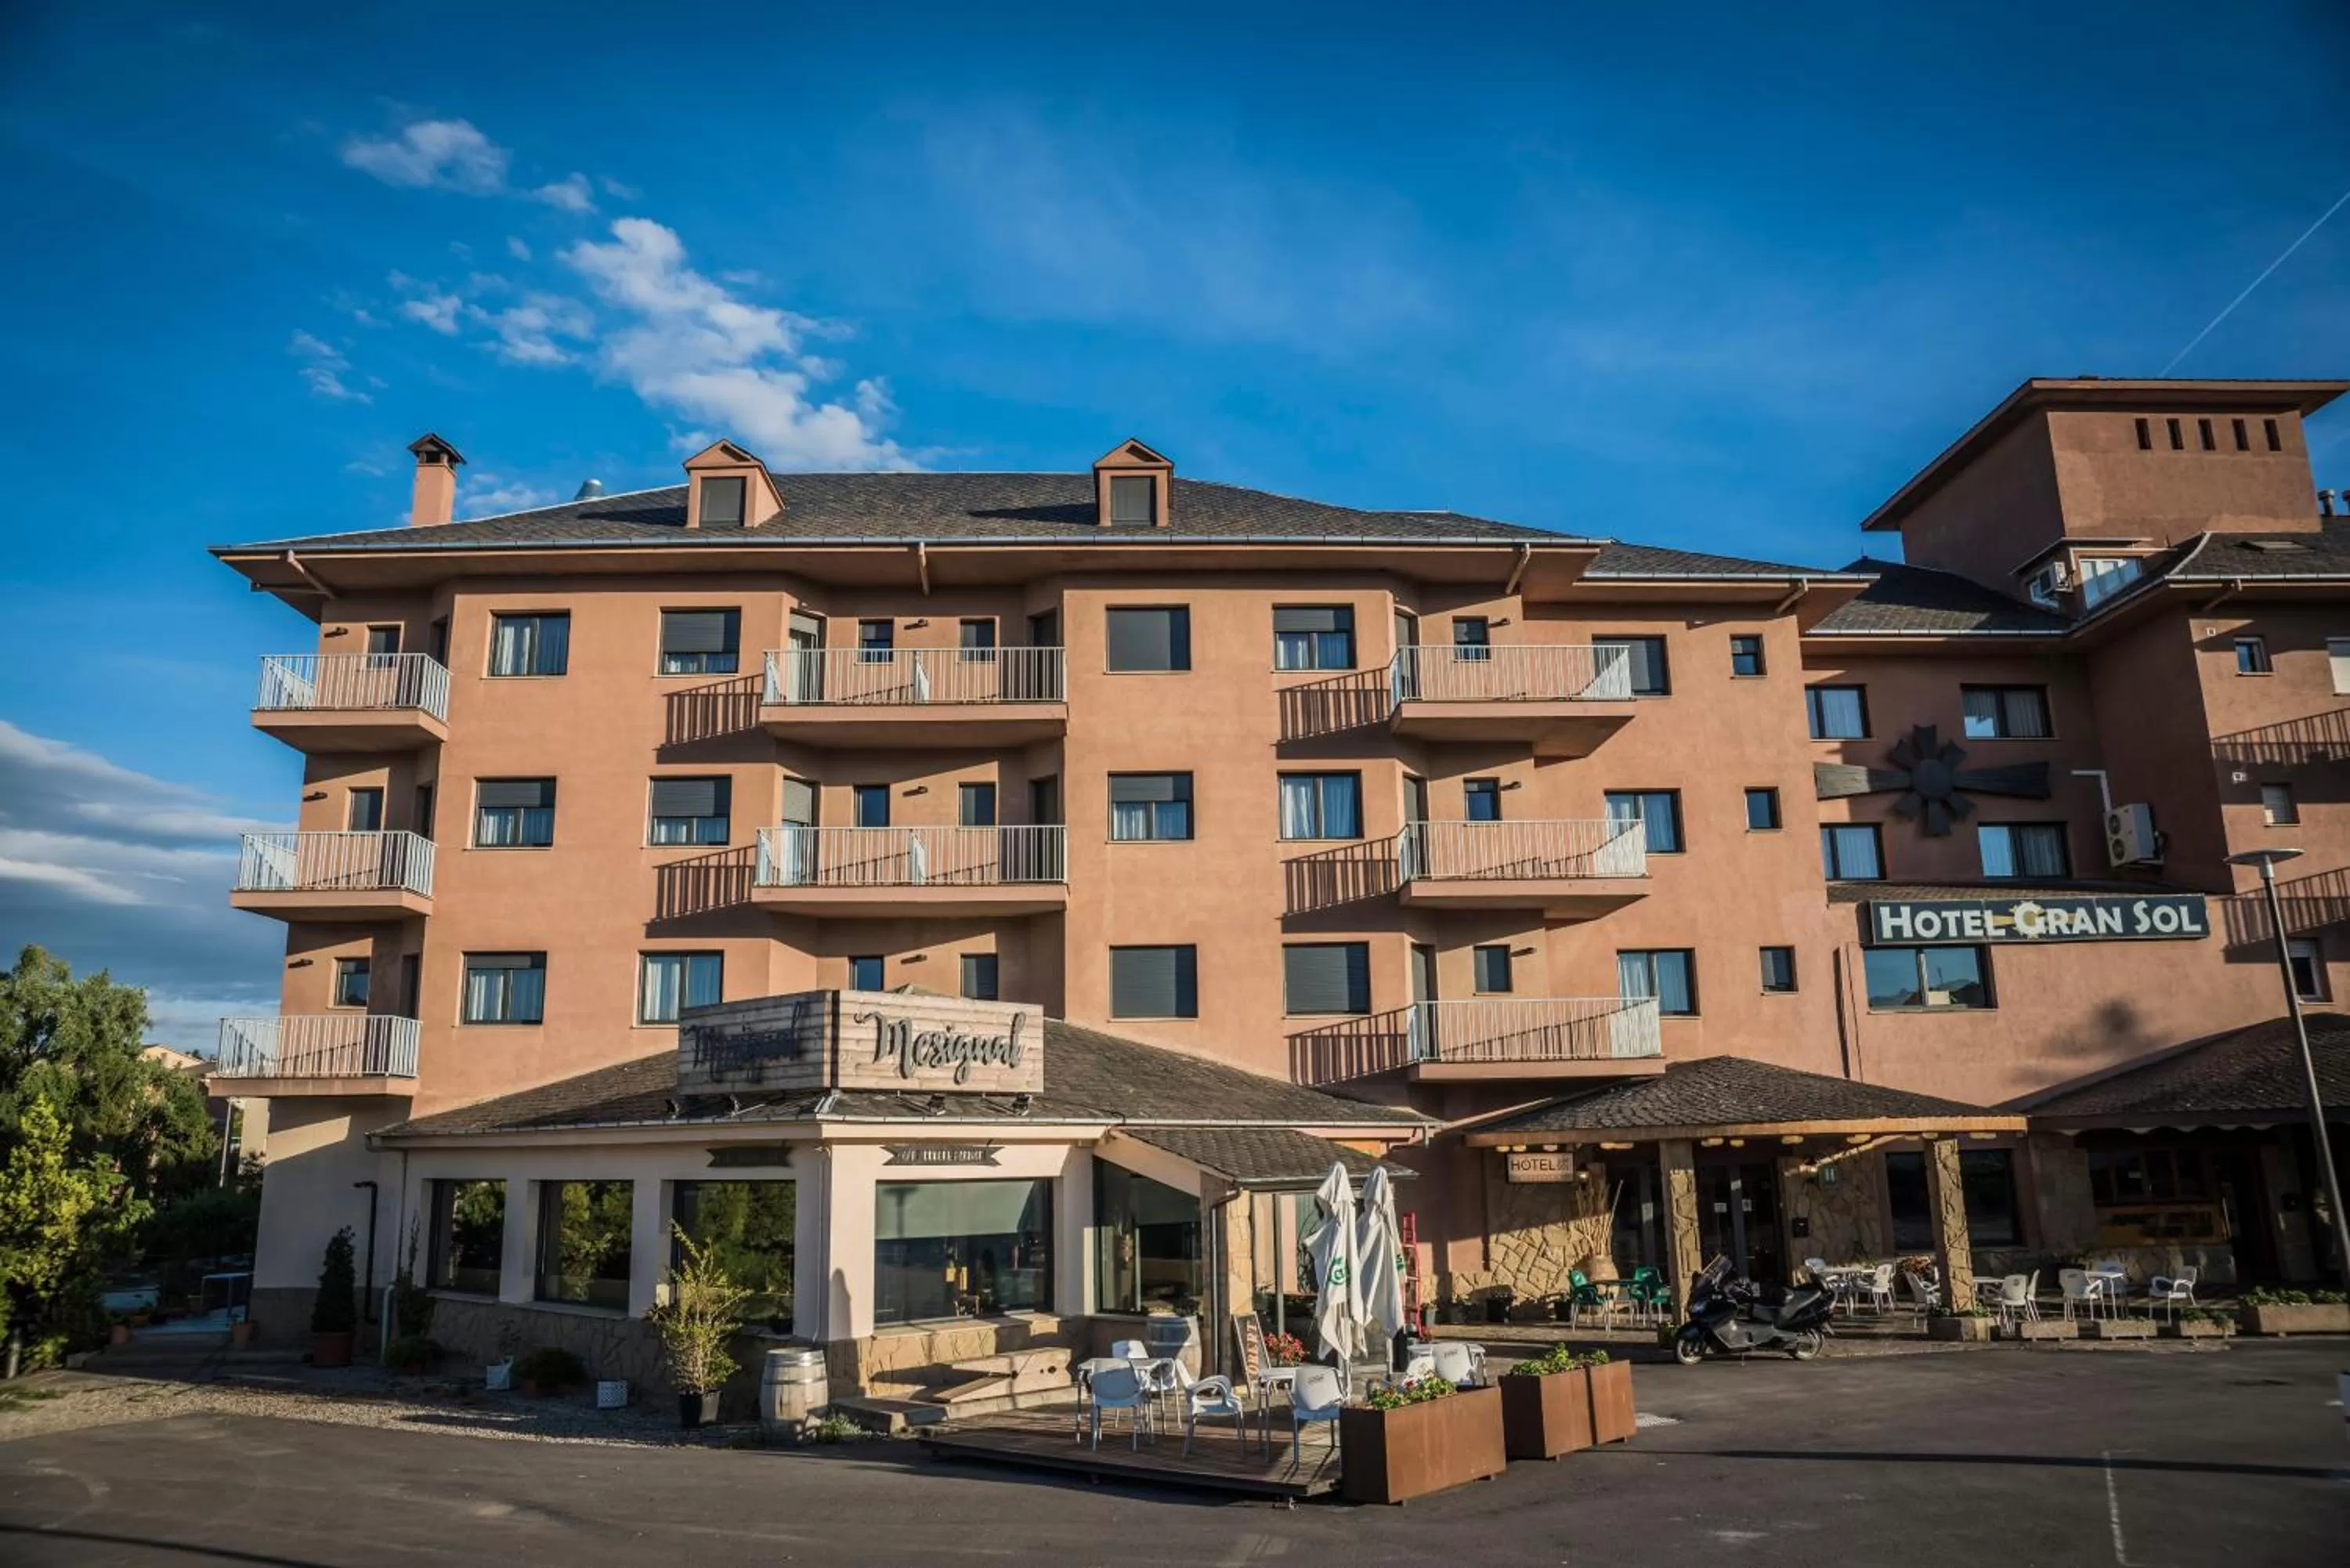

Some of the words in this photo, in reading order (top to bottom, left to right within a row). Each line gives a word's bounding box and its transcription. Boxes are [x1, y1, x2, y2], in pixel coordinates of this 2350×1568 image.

[1880, 905, 2005, 938] HOTEL
[2014, 901, 2124, 937] GRAN
[2133, 900, 2202, 934] SOL
[853, 1011, 1027, 1086] Mesigual
[1511, 1158, 1555, 1171] HOTEL
